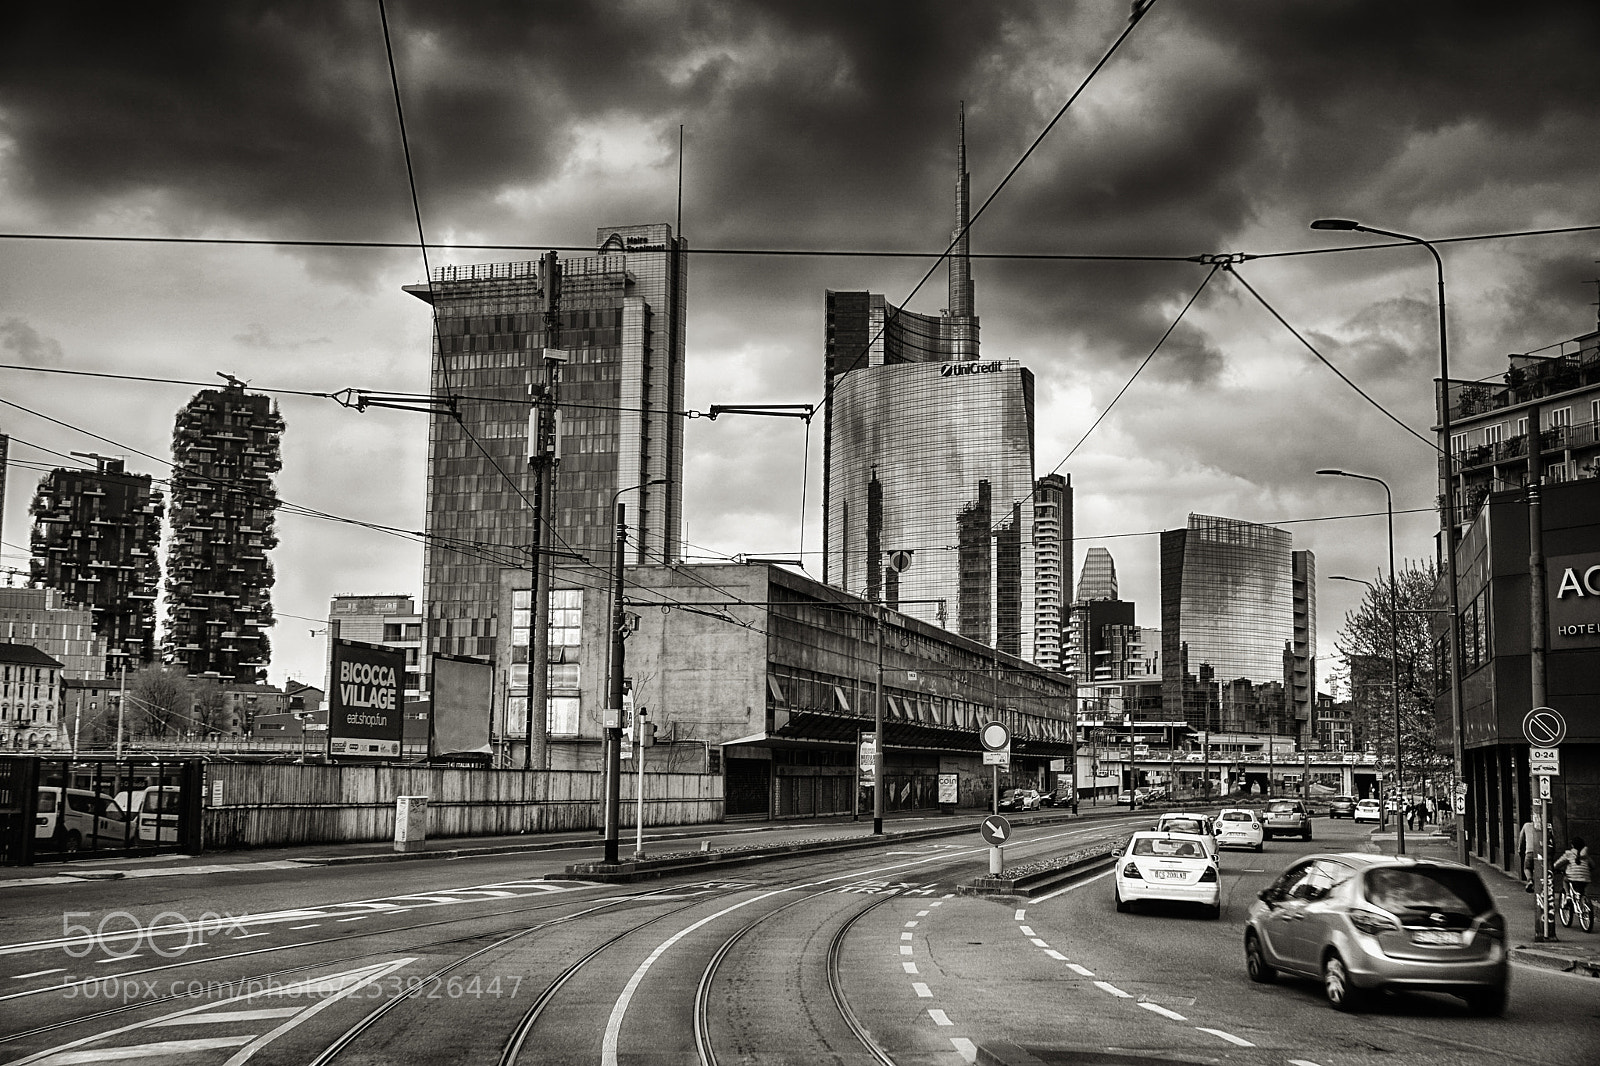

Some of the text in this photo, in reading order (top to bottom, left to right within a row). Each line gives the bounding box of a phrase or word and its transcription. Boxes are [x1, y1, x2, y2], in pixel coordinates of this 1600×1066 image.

[953, 361, 1002, 375] UniCredit
[340, 661, 396, 687] BICOCCA
[340, 683, 396, 710] VILLAGE
